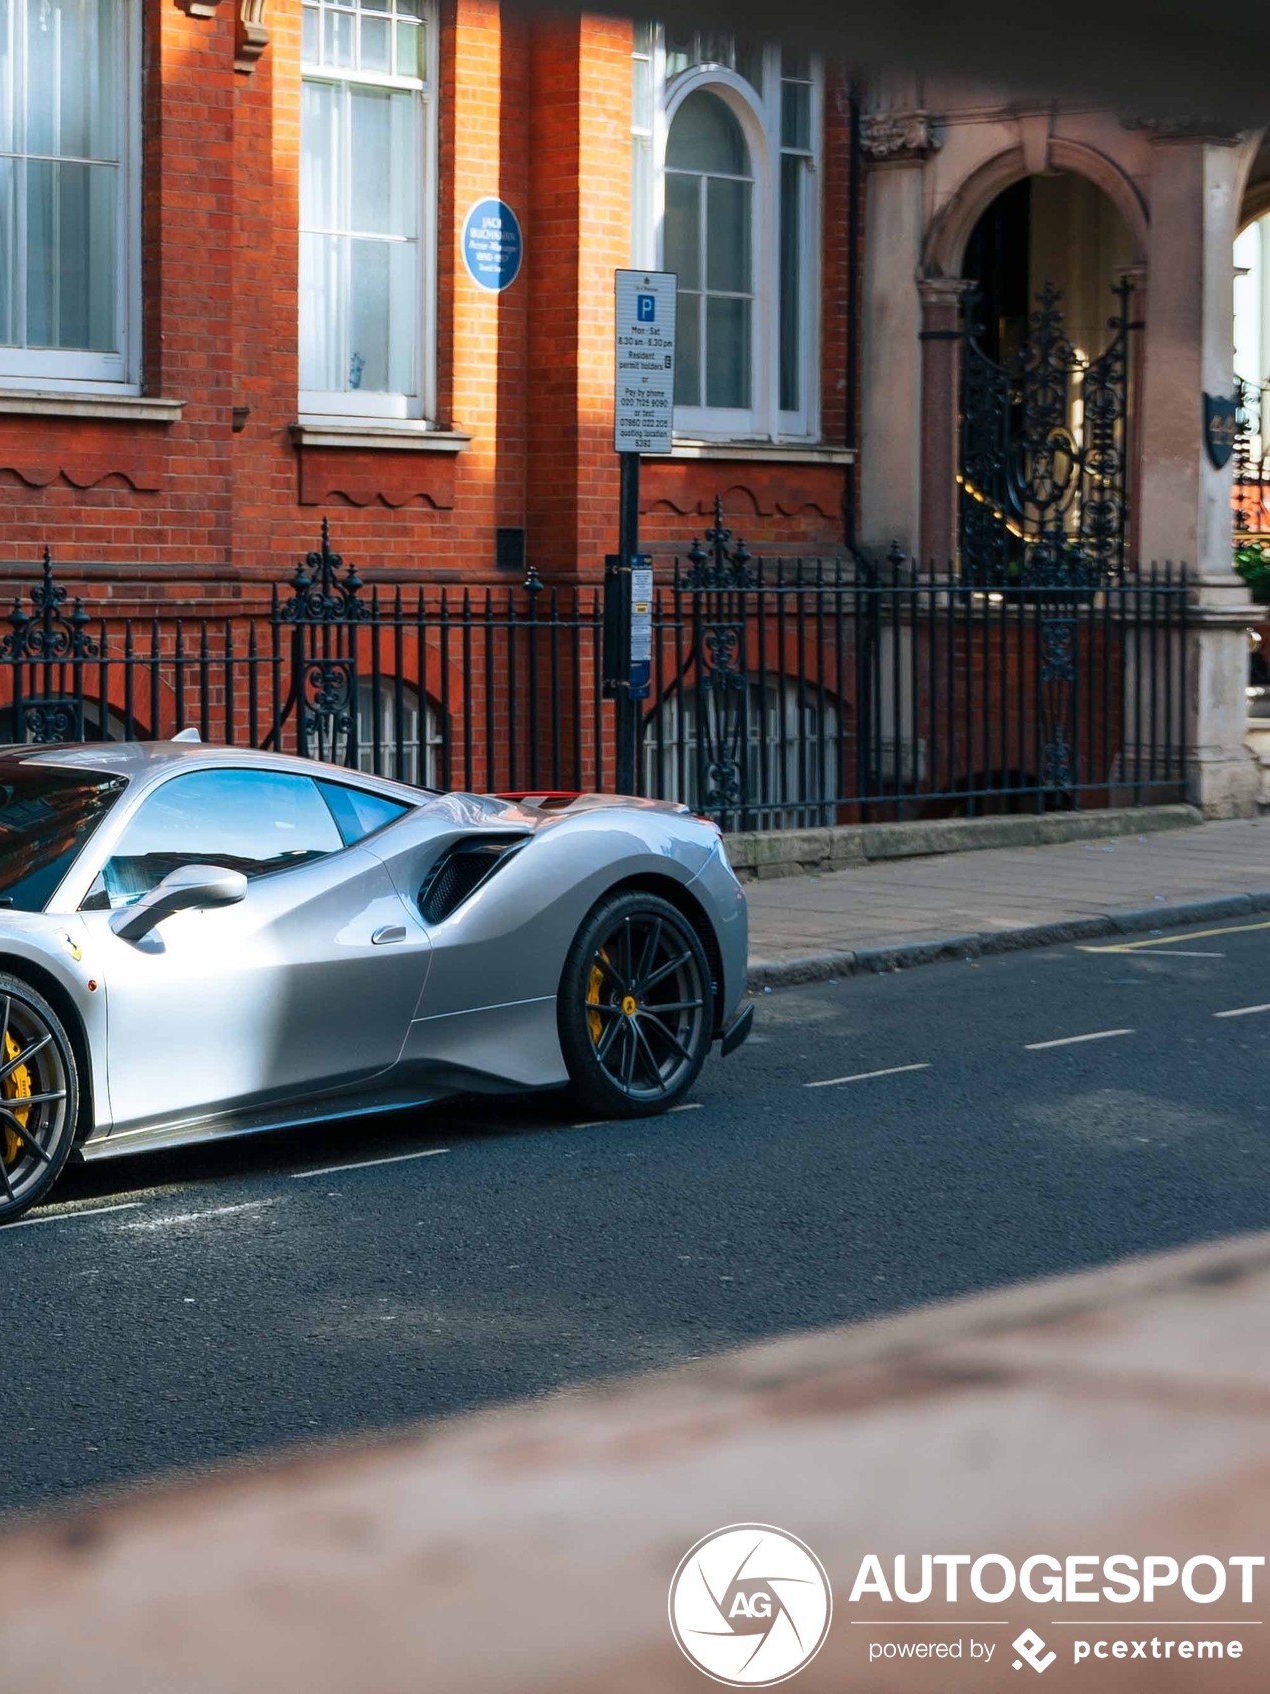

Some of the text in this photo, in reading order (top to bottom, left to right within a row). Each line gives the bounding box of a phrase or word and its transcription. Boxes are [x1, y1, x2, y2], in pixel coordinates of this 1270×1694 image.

[642, 299, 652, 319] P
[631, 326, 644, 335] Mon
[649, 326, 661, 336] Sat
[629, 350, 655, 360] Resident
[619, 362, 640, 370] permit
[641, 362, 664, 371] holders
[625, 387, 665, 399] Pay by phone
[642, 410, 655, 418] text
[619, 430, 668, 439] quoting location
